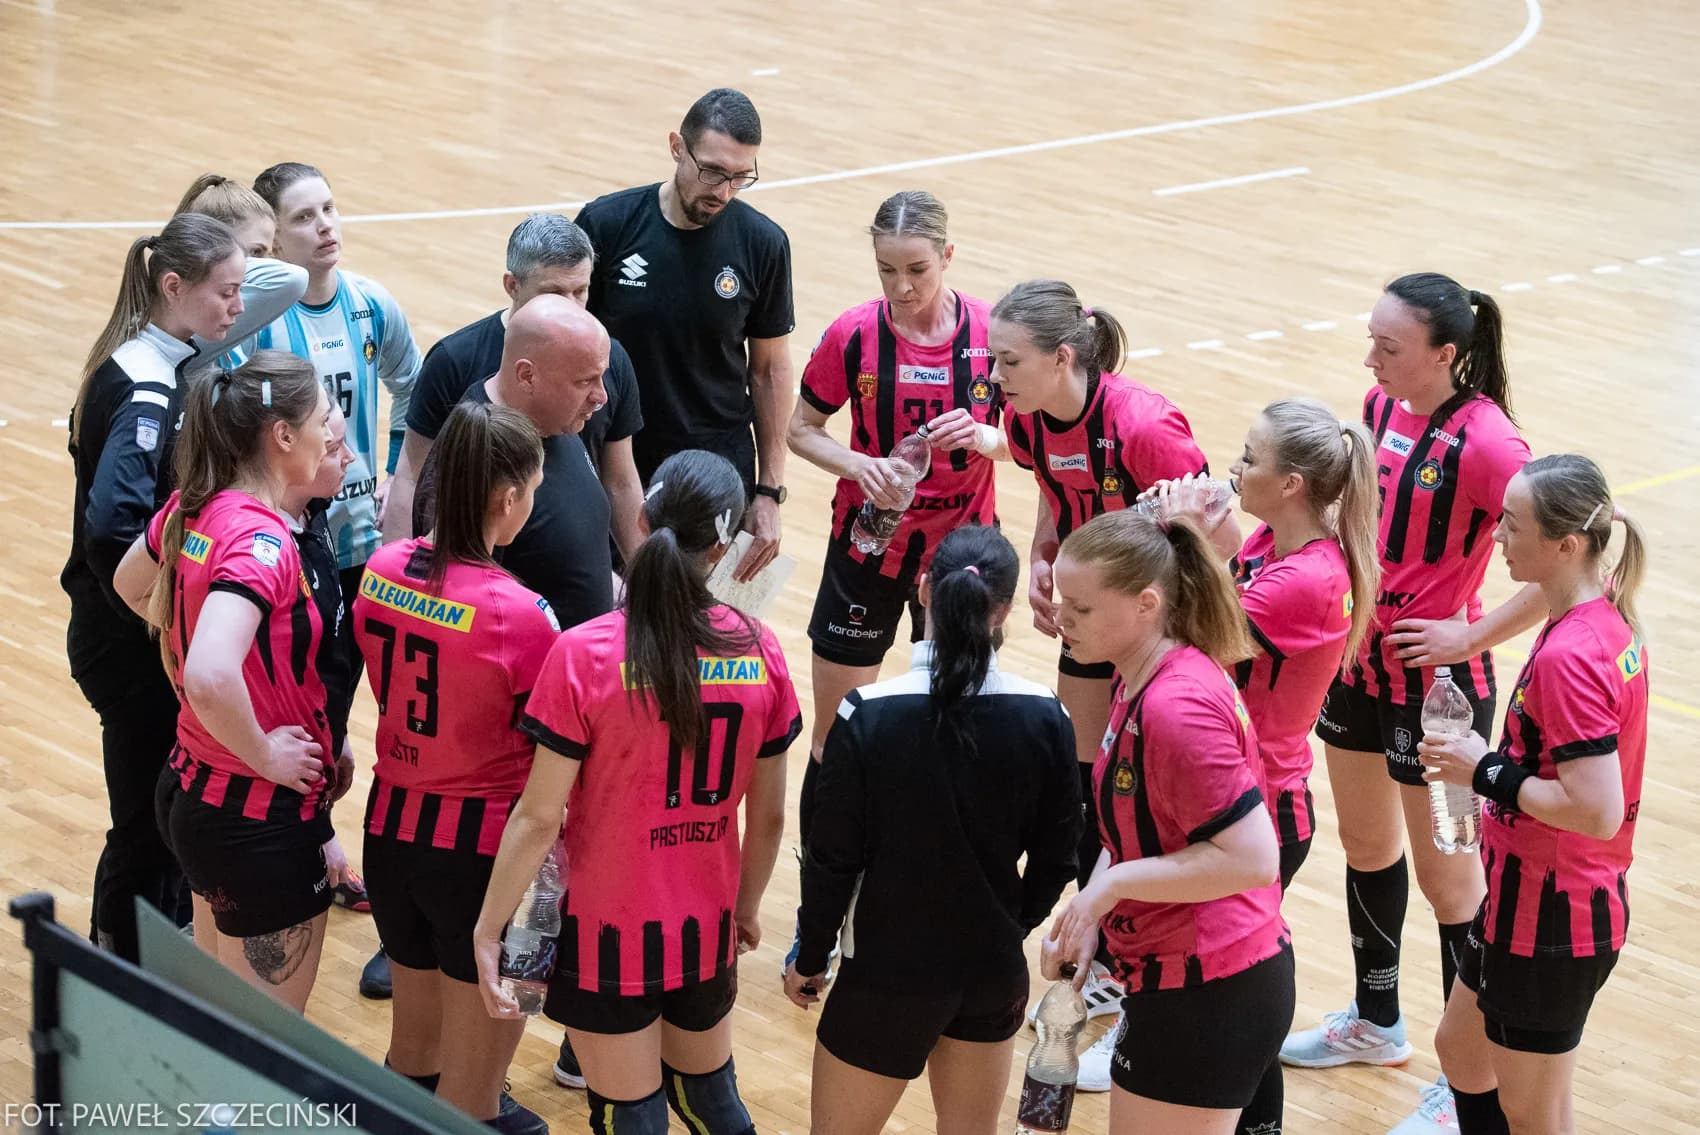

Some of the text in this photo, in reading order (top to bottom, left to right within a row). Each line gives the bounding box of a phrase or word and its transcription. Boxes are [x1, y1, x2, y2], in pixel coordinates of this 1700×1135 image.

[321, 339, 344, 351] PGNiG
[913, 371, 945, 381] PGNiG
[1390, 438, 1410, 452] PGNiG
[375, 582, 465, 626] LEWIATAN
[828, 620, 878, 640] karabela
[364, 616, 439, 738] 73
[658, 702, 745, 810] 10
[1385, 747, 1421, 767] PROFIK
